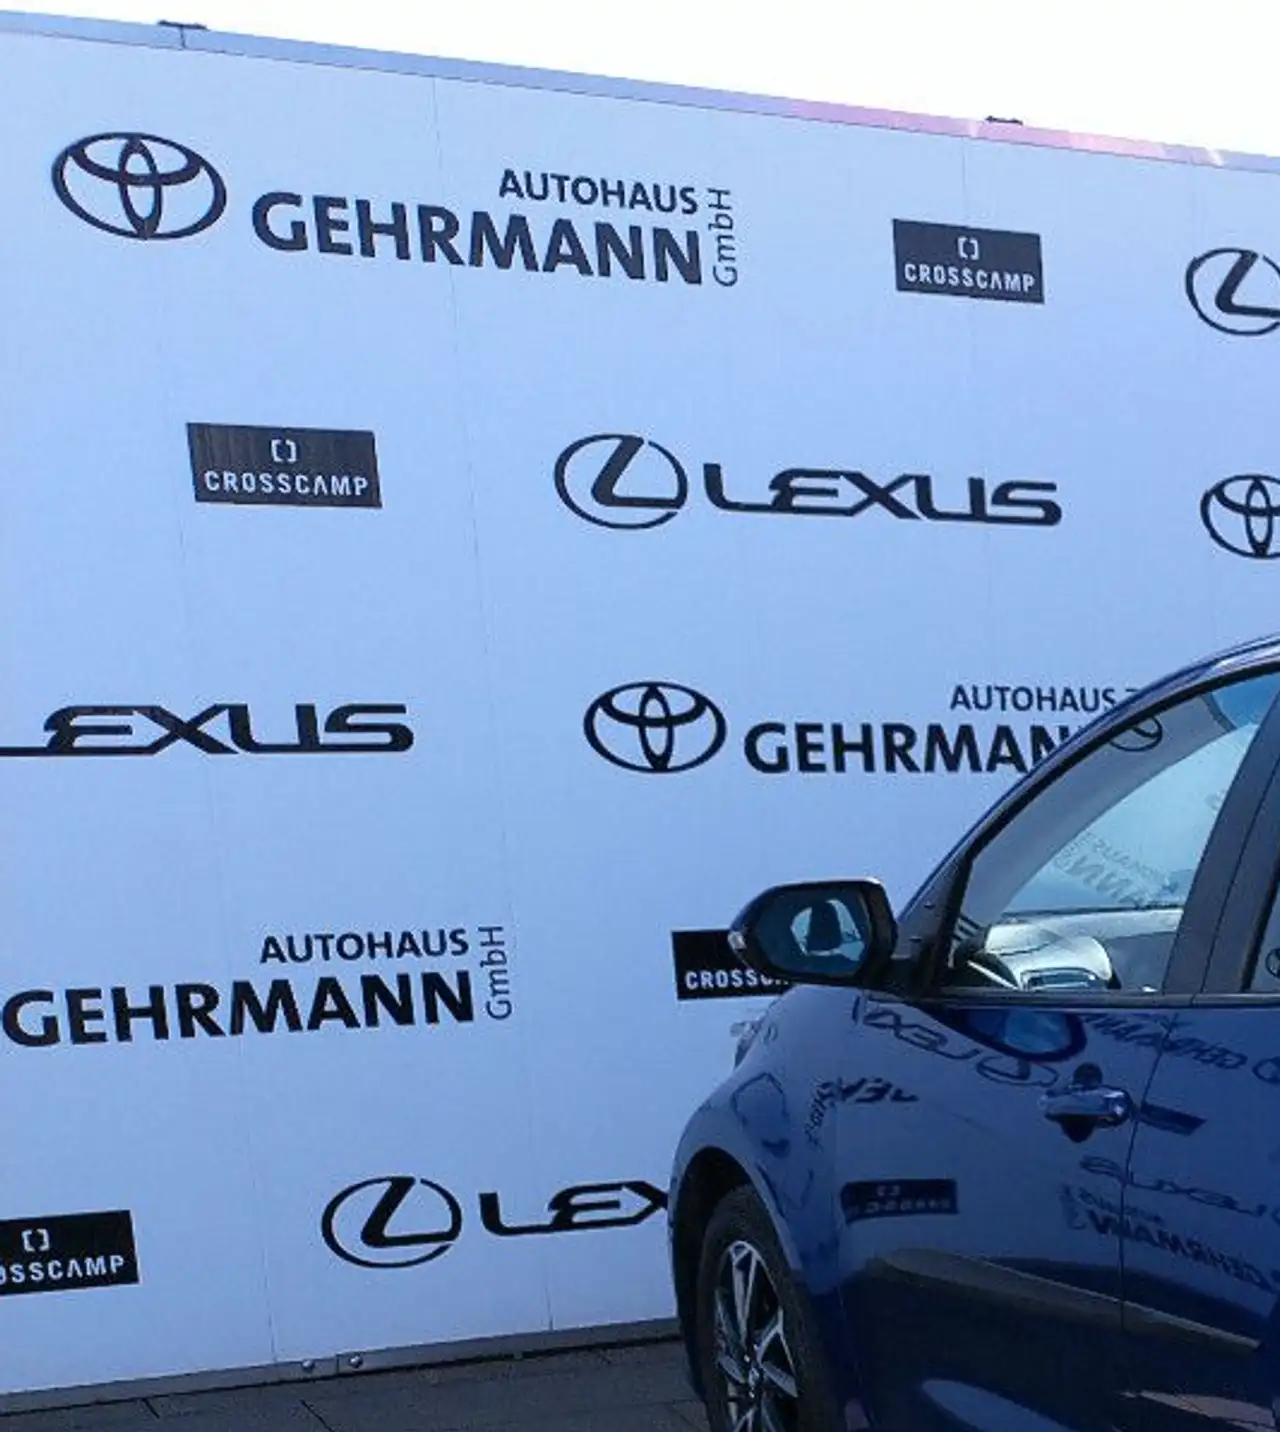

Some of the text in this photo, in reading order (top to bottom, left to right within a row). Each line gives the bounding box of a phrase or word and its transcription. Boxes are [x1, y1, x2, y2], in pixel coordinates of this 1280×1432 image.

[498, 168, 699, 215] AUTOHAUS
[251, 191, 703, 286] GEHRMANN
[708, 187, 738, 288] GmbH
[903, 263, 1035, 294] CROSSCAMP
[204, 470, 369, 497] CROSSCAMP
[703, 462, 1062, 527] LEXUS
[0, 703, 414, 758] EXUS
[259, 928, 469, 964] AUTOHAUS
[477, 926, 513, 1021] GmbH
[1, 970, 474, 1048] GEHRMANN
